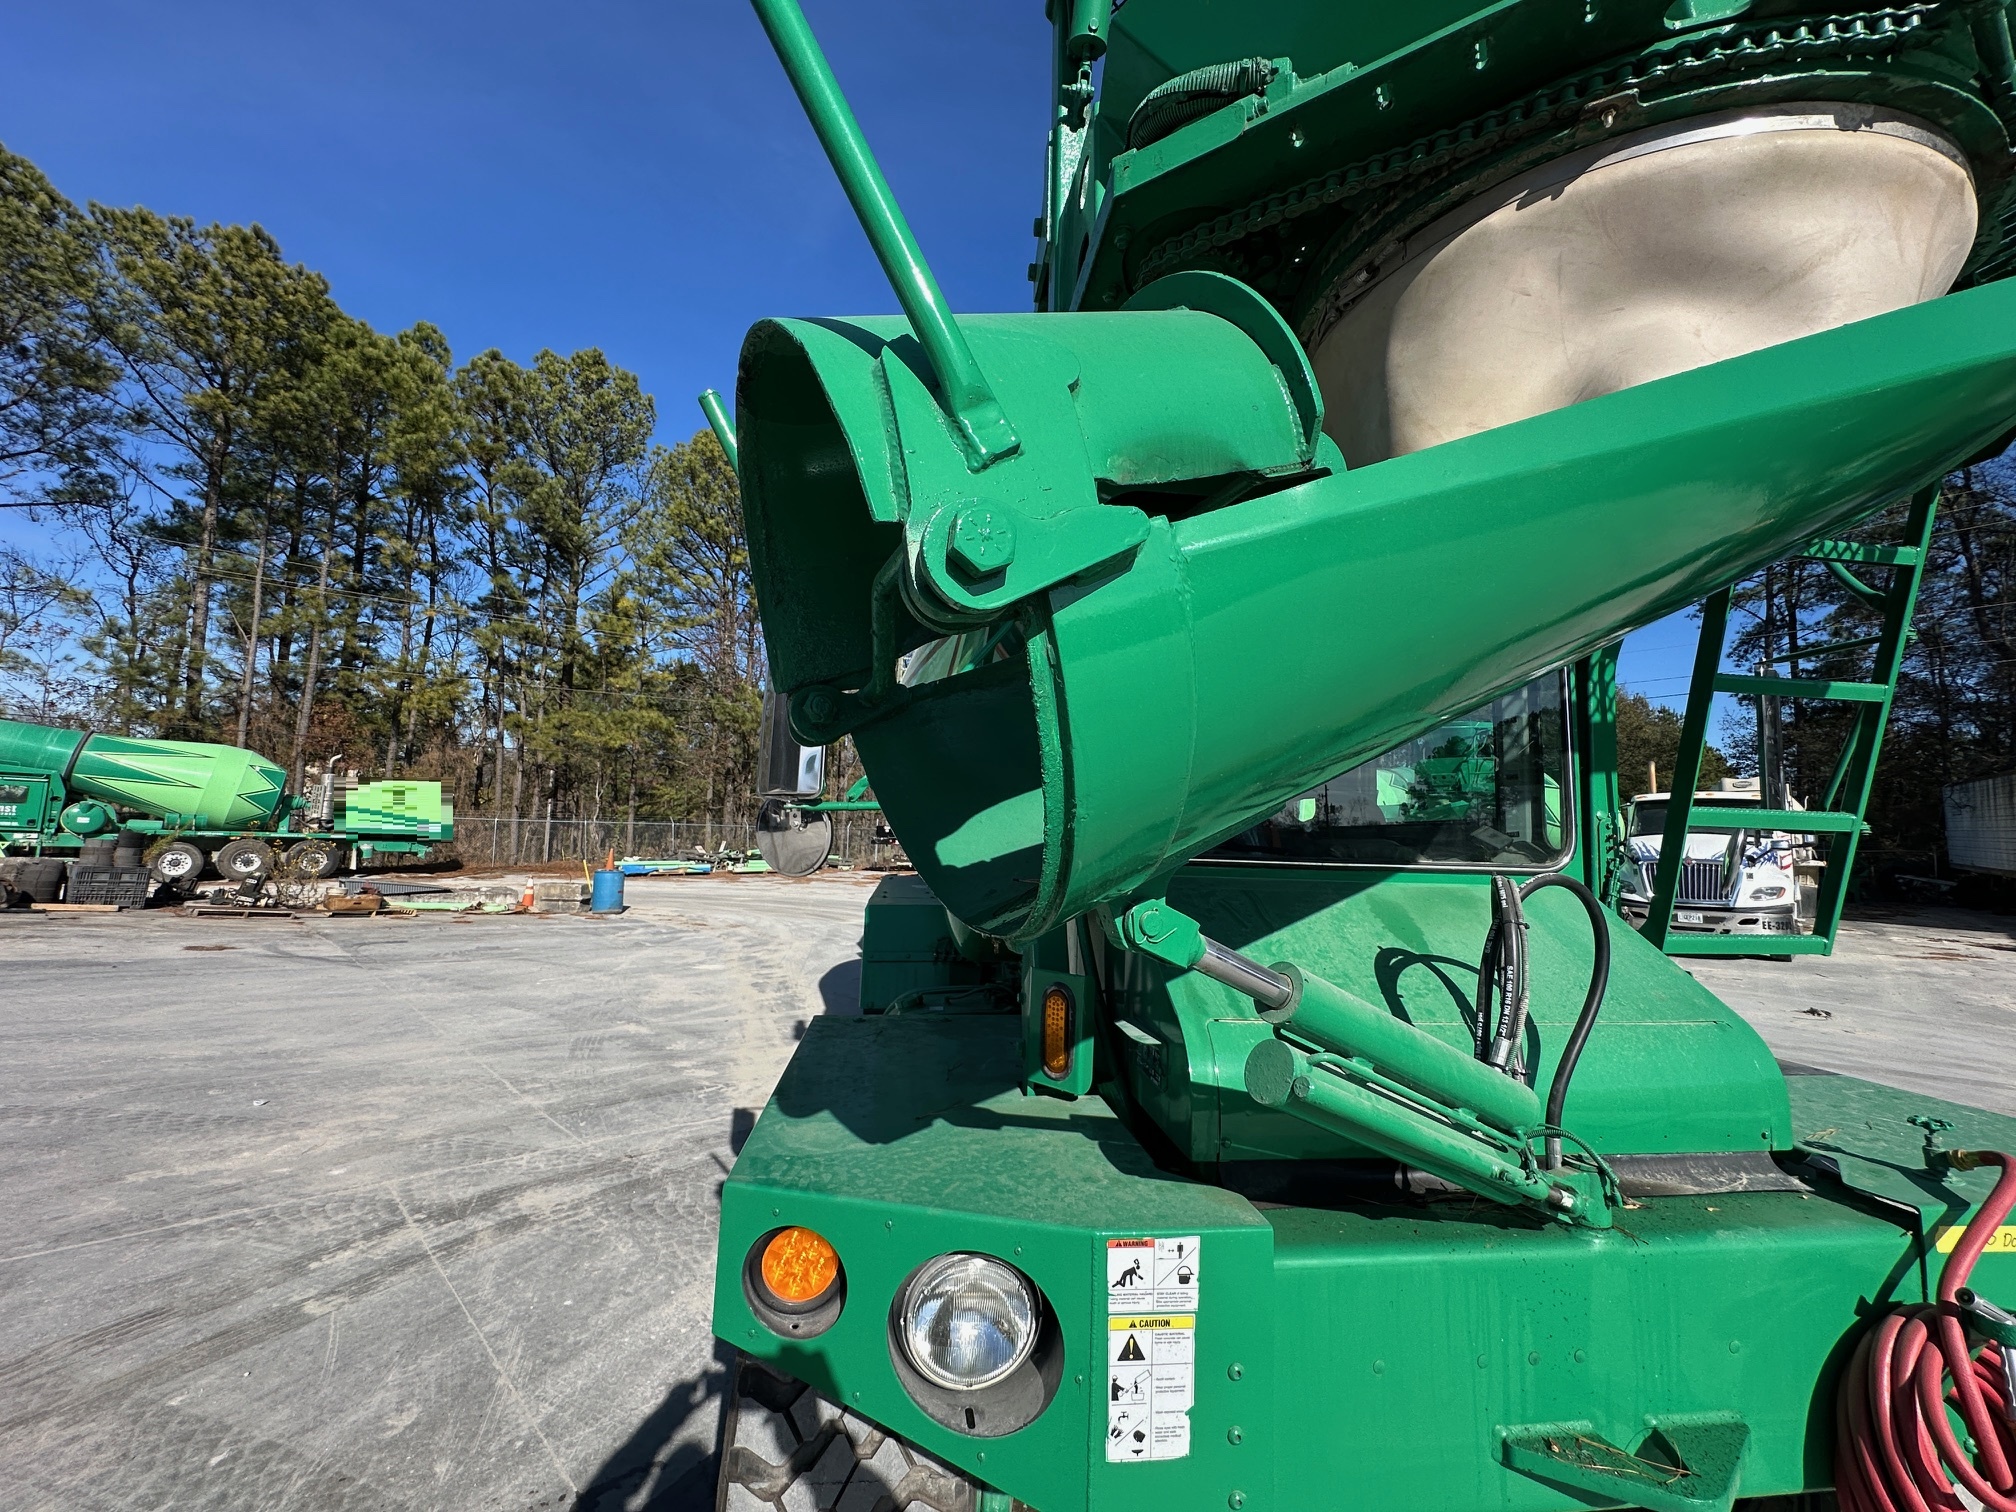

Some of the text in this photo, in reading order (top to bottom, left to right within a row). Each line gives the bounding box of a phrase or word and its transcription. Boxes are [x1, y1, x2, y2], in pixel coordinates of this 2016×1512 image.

[1506, 965, 1514, 980] SAE
[1505, 980, 1513, 992] 100
[1503, 1005, 1511, 1016] DN
[1501, 1016, 1509, 1024] 13
[1139, 1318, 1171, 1328] CAUTION
